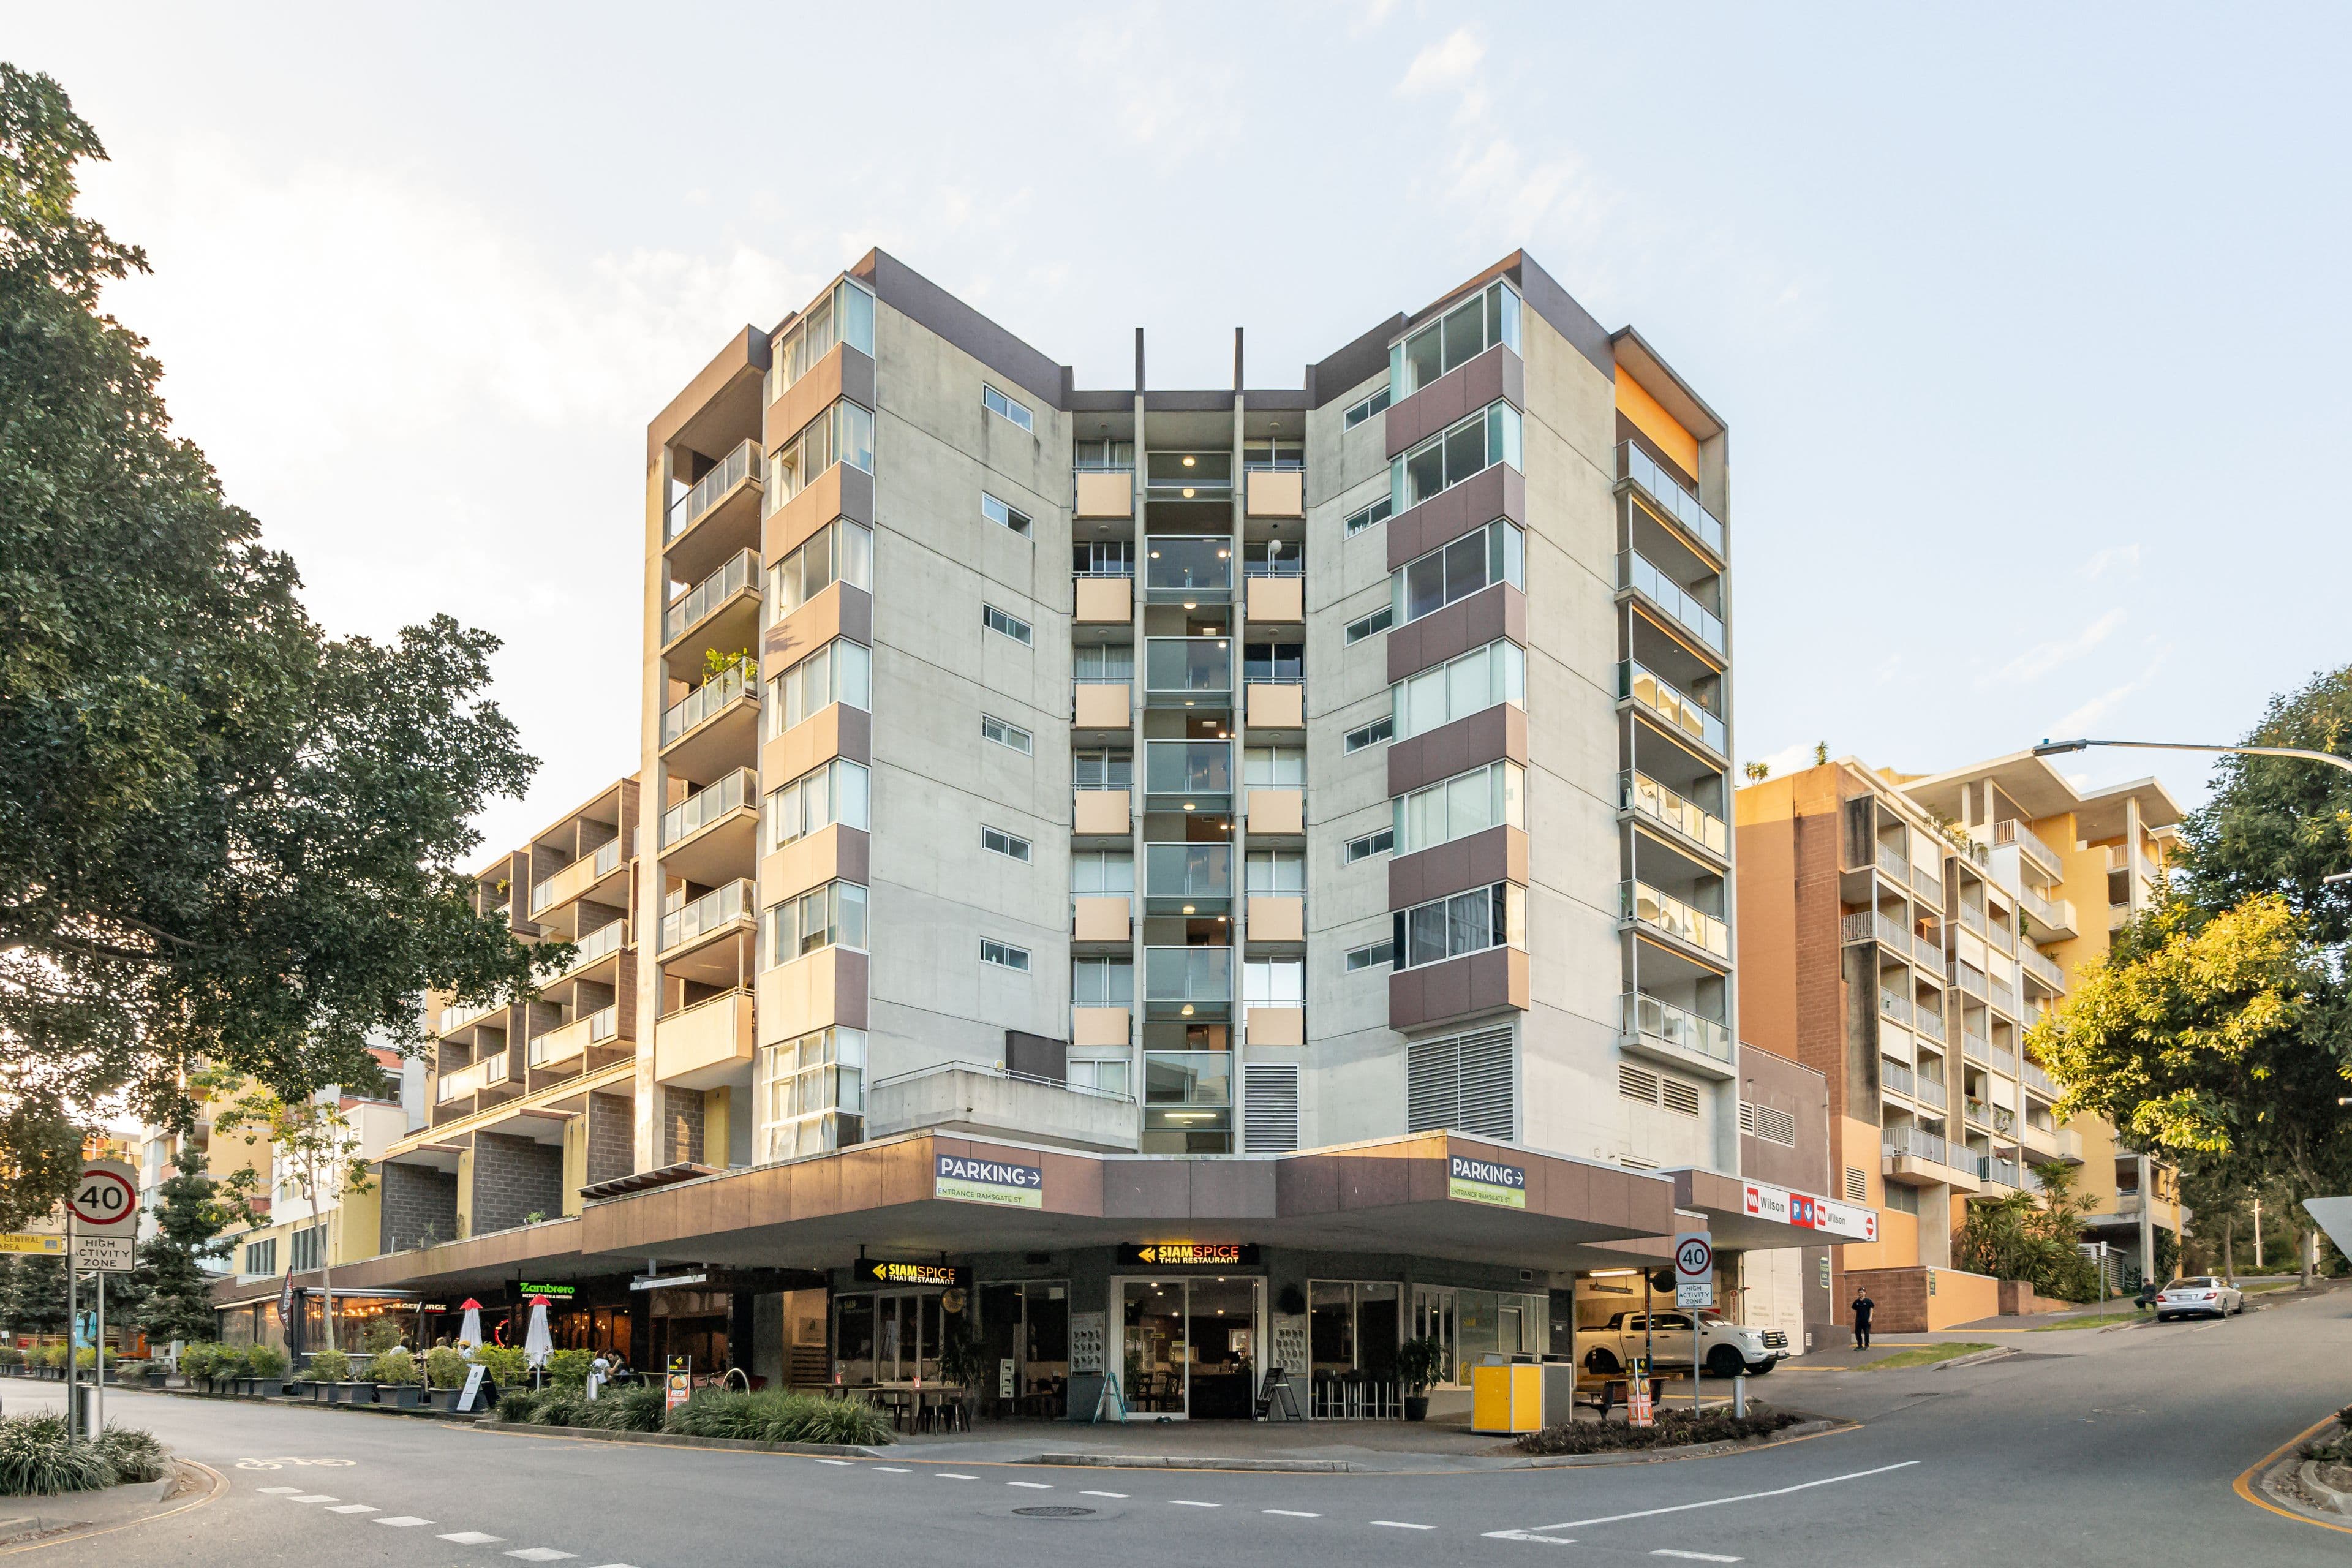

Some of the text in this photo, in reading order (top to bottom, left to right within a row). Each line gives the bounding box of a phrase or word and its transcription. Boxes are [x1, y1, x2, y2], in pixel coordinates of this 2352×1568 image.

[941, 1158, 1025, 1185] PARKING
[1453, 1158, 1513, 1185] PARKING
[78, 1186, 123, 1210] 40
[938, 1188, 974, 1197] ENTRANCE
[976, 1193, 1012, 1202] RAMSGATE
[1451, 1188, 1477, 1198] ENTRANCE
[1479, 1193, 1504, 1202] RAMSGATE
[1760, 1196, 1784, 1213] Wilson
[1827, 1212, 1845, 1225] Wilson
[83, 1259, 116, 1267] ZONE
[1682, 1248, 1705, 1265] 40
[519, 1283, 575, 1294] Zambrero
